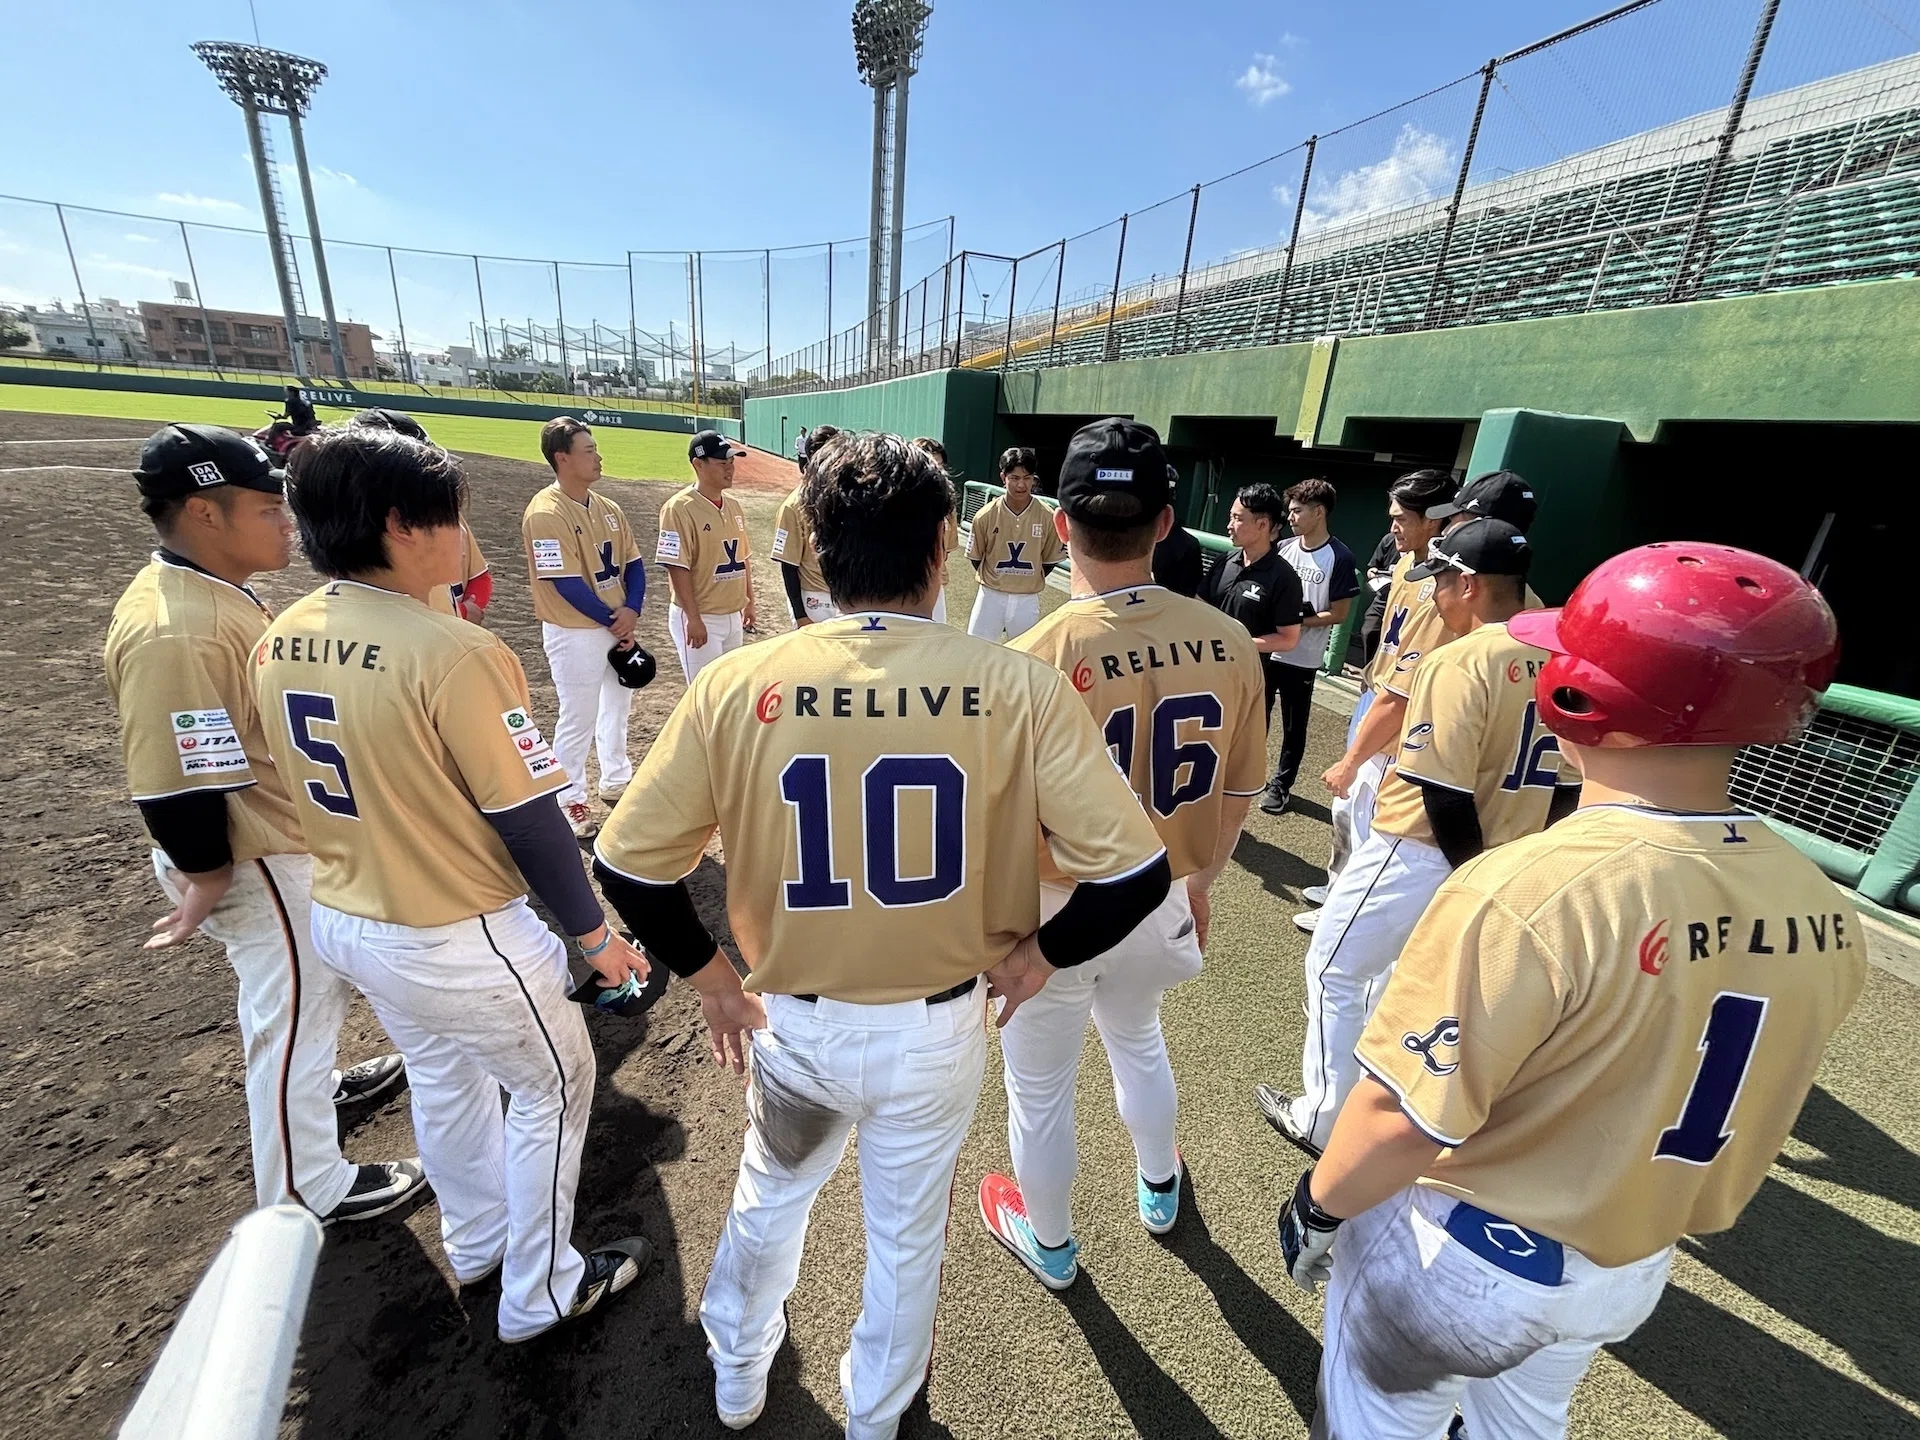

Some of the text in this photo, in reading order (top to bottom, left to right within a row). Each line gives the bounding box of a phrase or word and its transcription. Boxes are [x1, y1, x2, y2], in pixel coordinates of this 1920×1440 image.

[199, 735, 237, 746] JTA
[282, 689, 361, 822] 5
[529, 756, 550, 767] HOTEL
[1102, 690, 1224, 820] 16
[778, 753, 968, 912] 10
[1650, 990, 1771, 1167] 1
